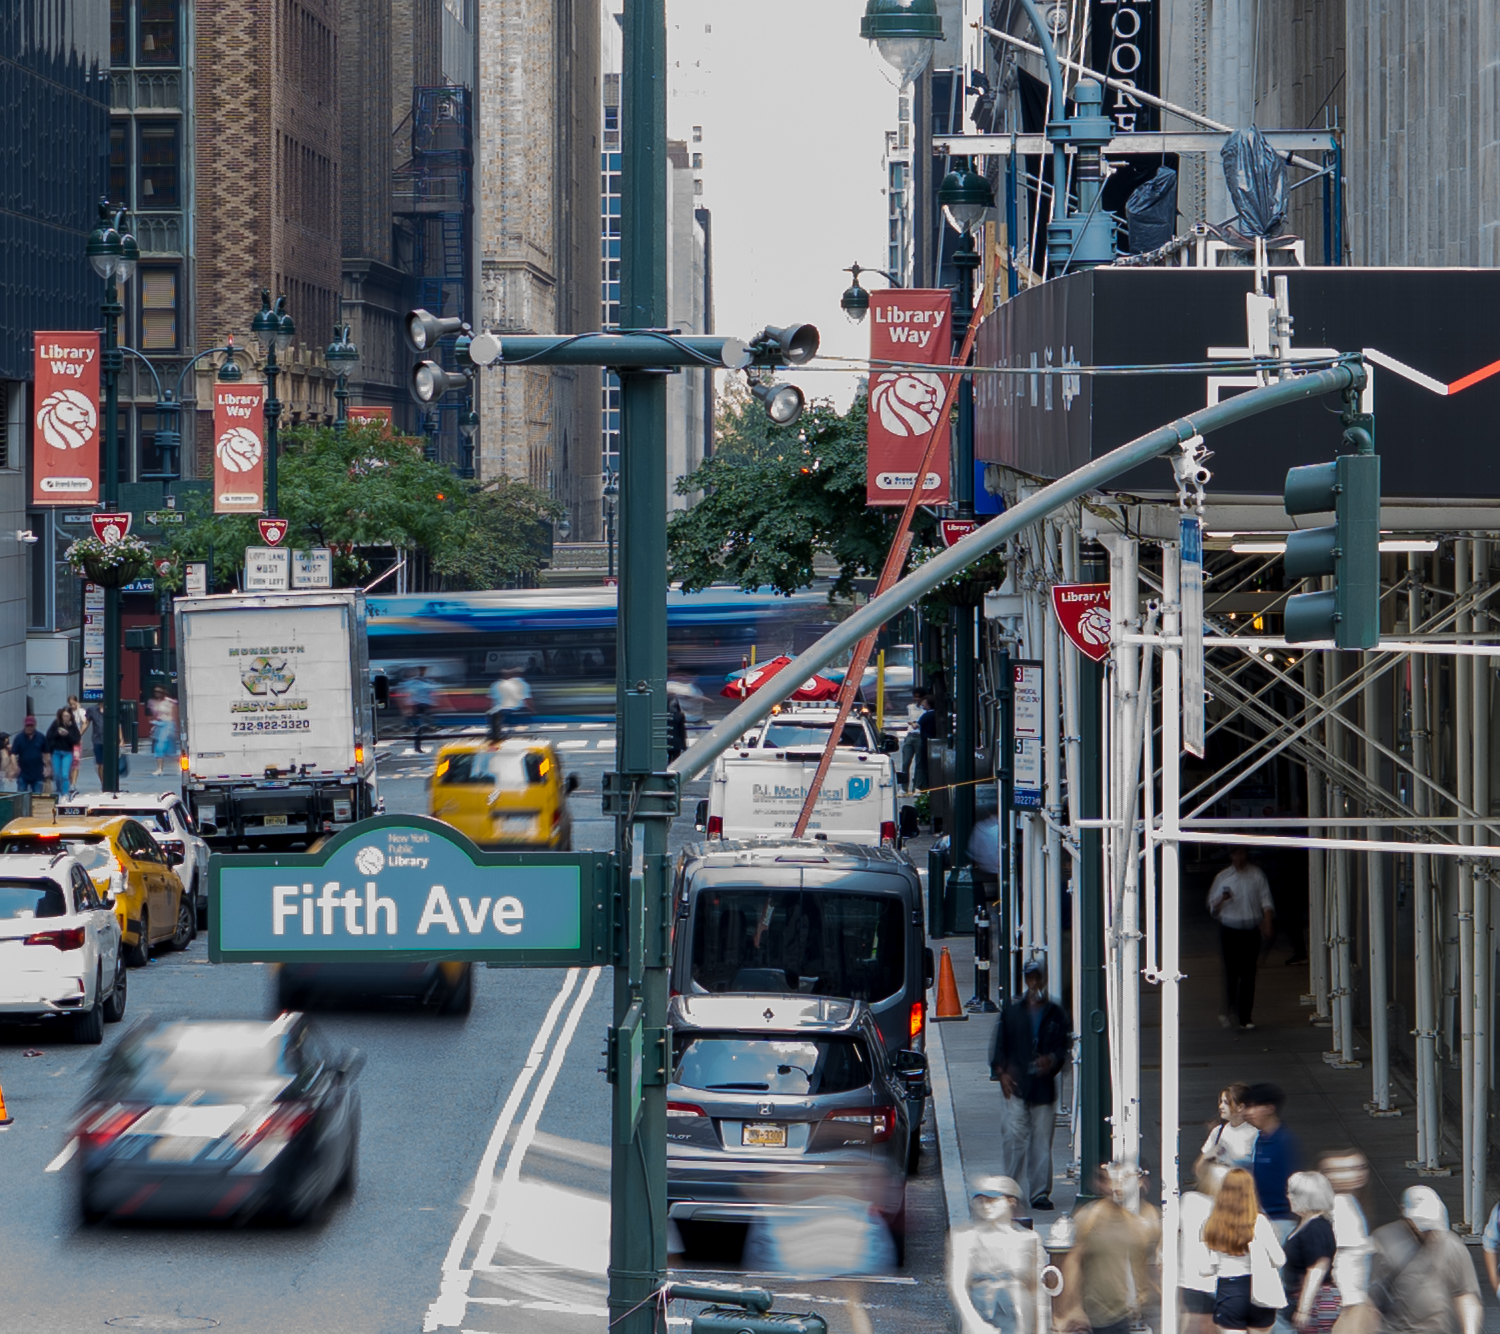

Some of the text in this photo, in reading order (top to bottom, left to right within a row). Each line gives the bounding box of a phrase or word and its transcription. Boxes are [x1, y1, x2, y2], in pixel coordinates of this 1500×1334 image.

[876, 306, 944, 328] Library
[889, 326, 931, 347] Way
[40, 344, 95, 363] Library
[51, 361, 85, 378] Way
[218, 394, 260, 407] Library
[226, 406, 252, 419] Way
[1061, 591, 1100, 604] Library
[1016, 667, 1022, 681] 3
[232, 719, 310, 731] 732-922-3320
[1016, 739, 1022, 753] 5
[388, 833, 430, 843] New York
[388, 845, 414, 854] Public
[388, 855, 430, 869] Library
[273, 882, 524, 935] Fifth Ave
